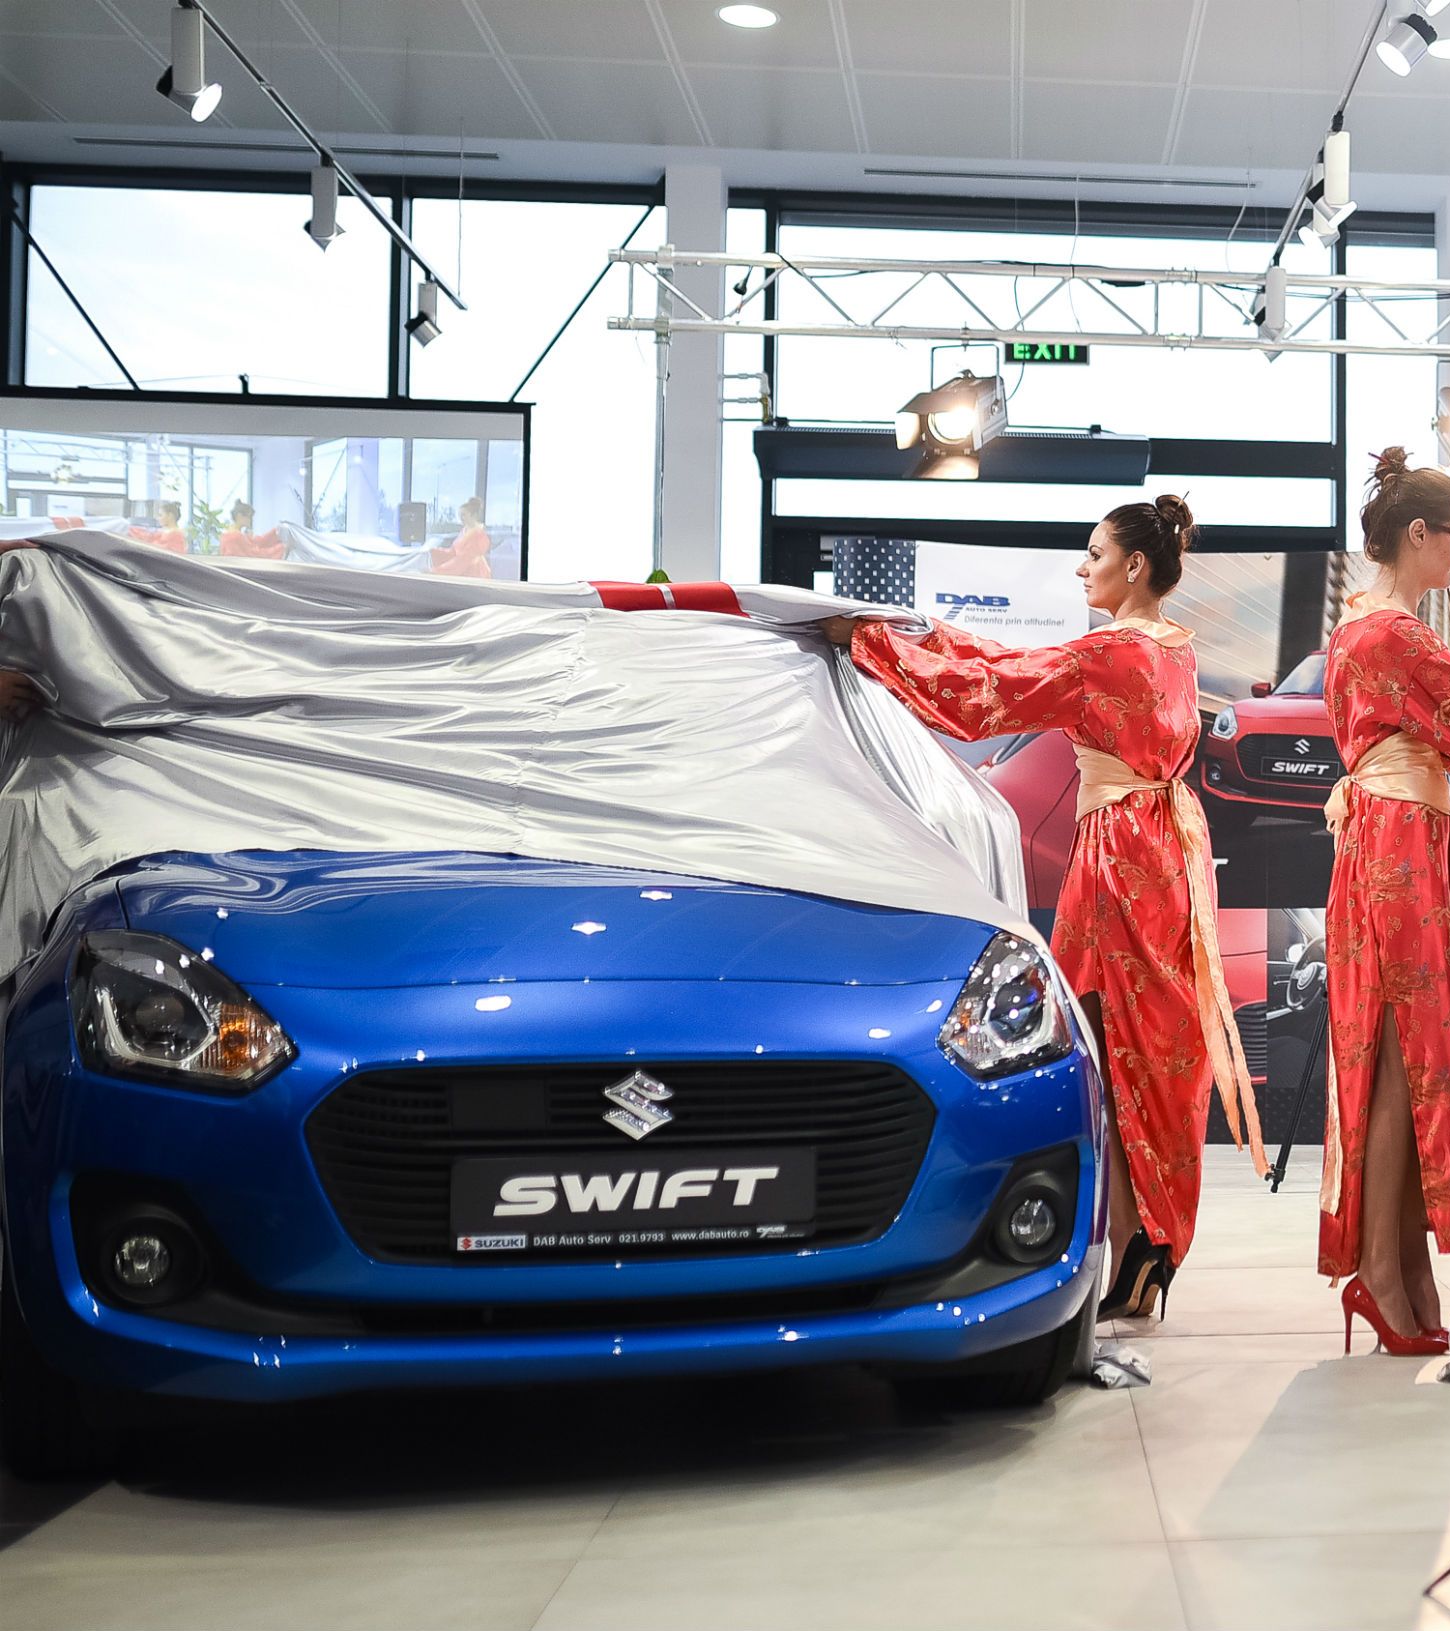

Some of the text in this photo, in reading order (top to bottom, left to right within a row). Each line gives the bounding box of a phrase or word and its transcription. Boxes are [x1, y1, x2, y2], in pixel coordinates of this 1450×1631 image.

[935, 593, 1010, 607] DAB
[1005, 617, 1022, 628] prin
[1271, 761, 1330, 776] SWIFT
[493, 1167, 779, 1216] SWIFT
[474, 1238, 524, 1248] SUZUKI
[533, 1236, 555, 1246] DAB
[558, 1235, 584, 1246] Auto
[587, 1234, 611, 1244] Serv
[618, 1233, 664, 1243] 021.9793
[671, 1230, 749, 1241] www.dabauto.ro
